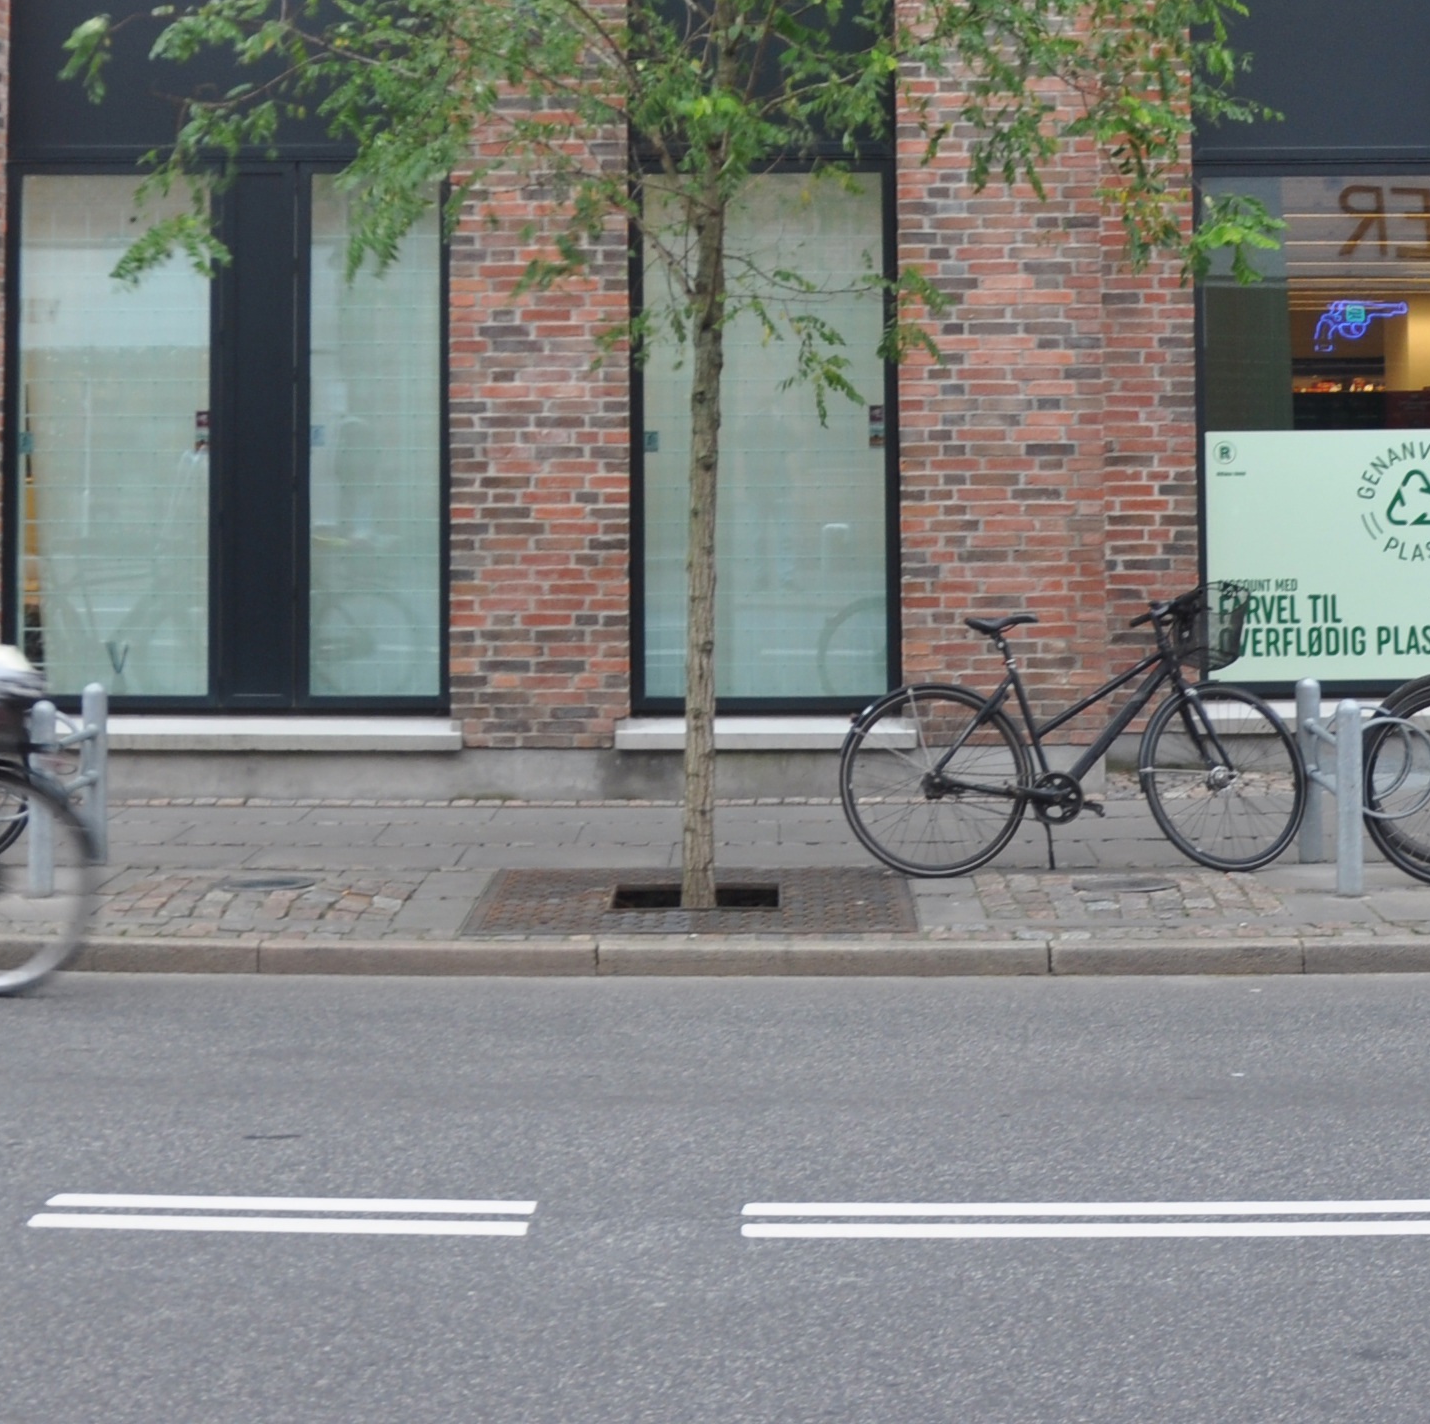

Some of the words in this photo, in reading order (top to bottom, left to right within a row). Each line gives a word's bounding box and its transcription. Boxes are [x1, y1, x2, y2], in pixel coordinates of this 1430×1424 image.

[1218, 579, 1272, 594] DCOUNT
[1274, 578, 1299, 592] MED
[1218, 594, 1301, 625] FARVEL
[1307, 594, 1343, 624] TIL
